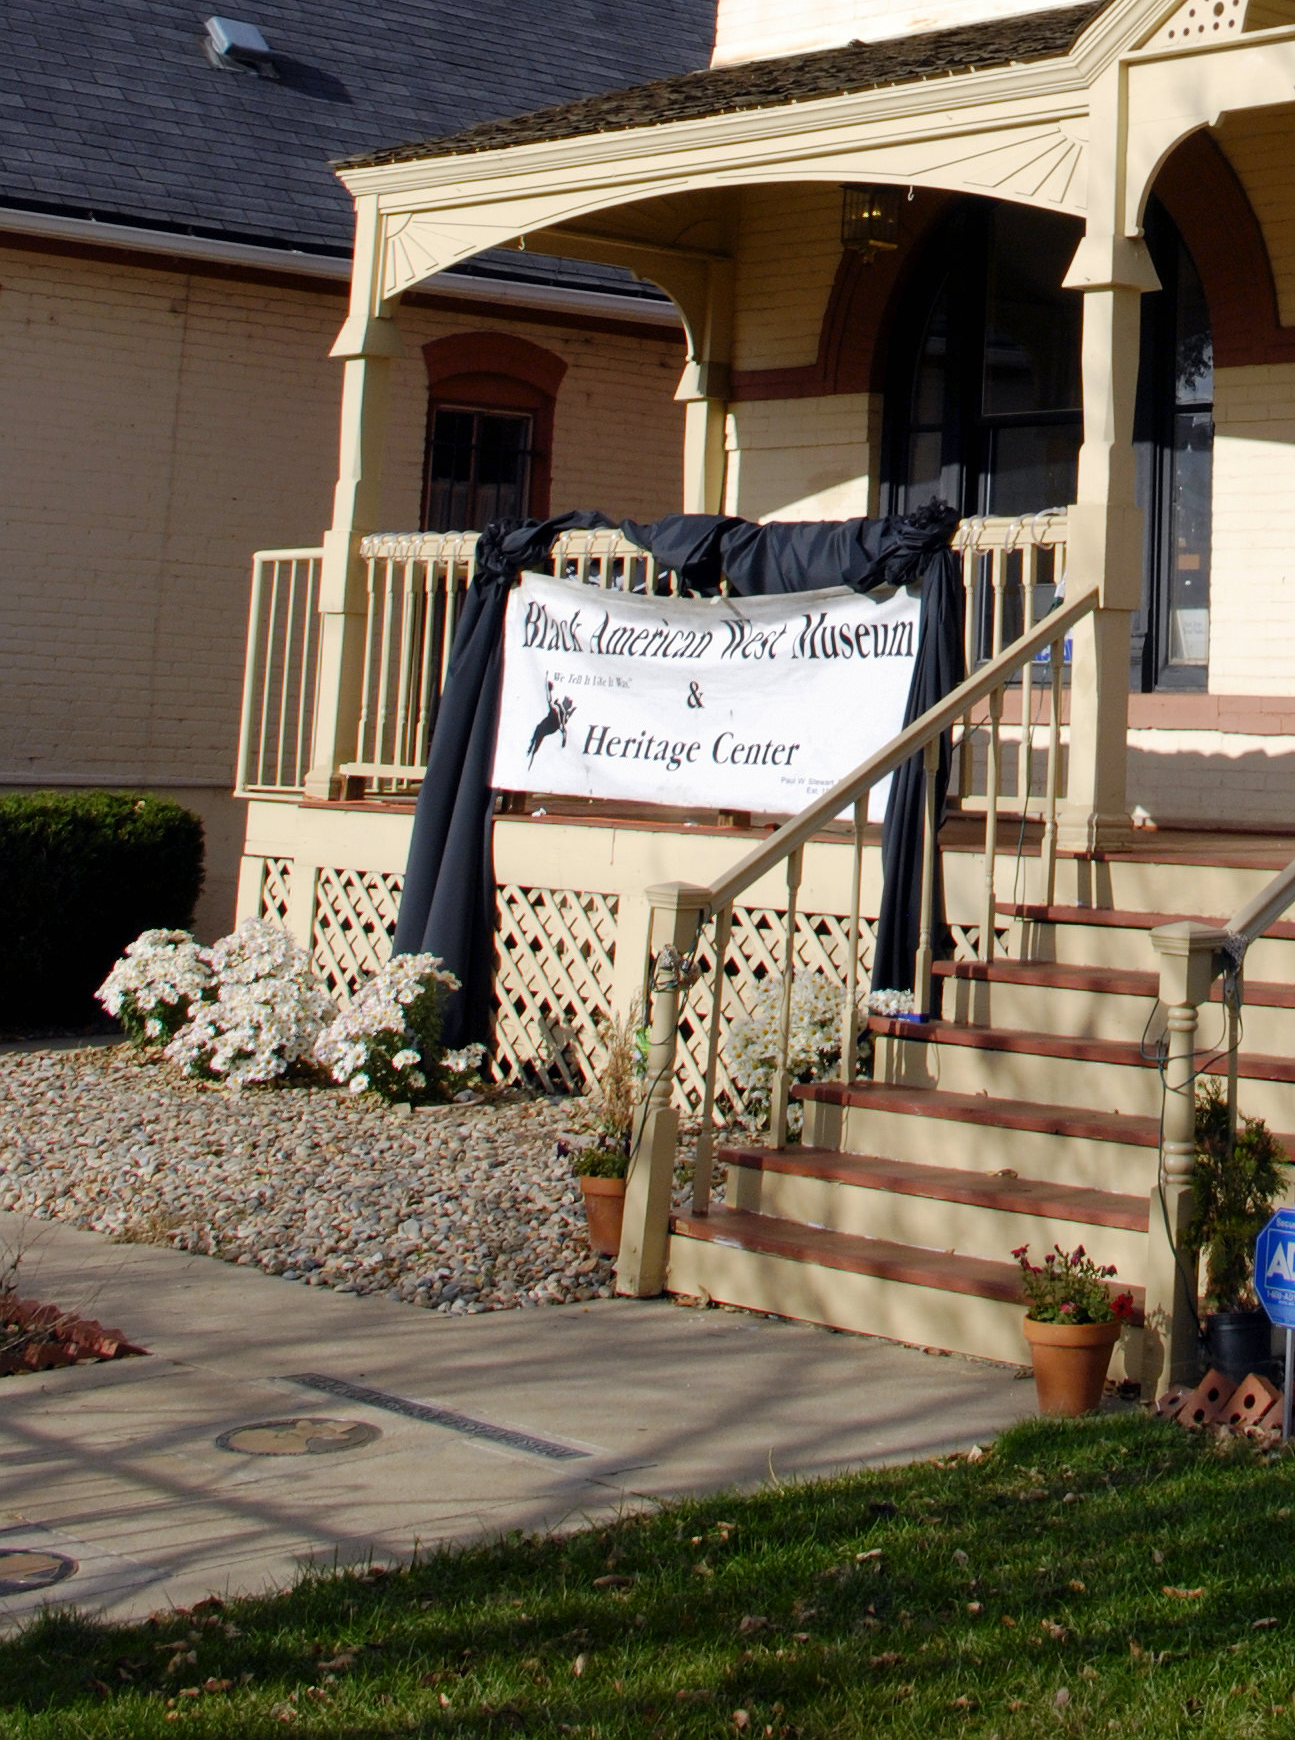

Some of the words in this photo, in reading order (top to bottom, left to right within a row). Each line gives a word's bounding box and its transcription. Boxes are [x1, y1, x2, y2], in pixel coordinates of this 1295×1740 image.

[522, 600, 583, 653] Black
[590, 610, 713, 658] American
[720, 618, 787, 659] West
[791, 612, 914, 659] Museum
[687, 681, 705, 709] &
[582, 724, 701, 772] Heritage
[712, 731, 800, 766] Center
